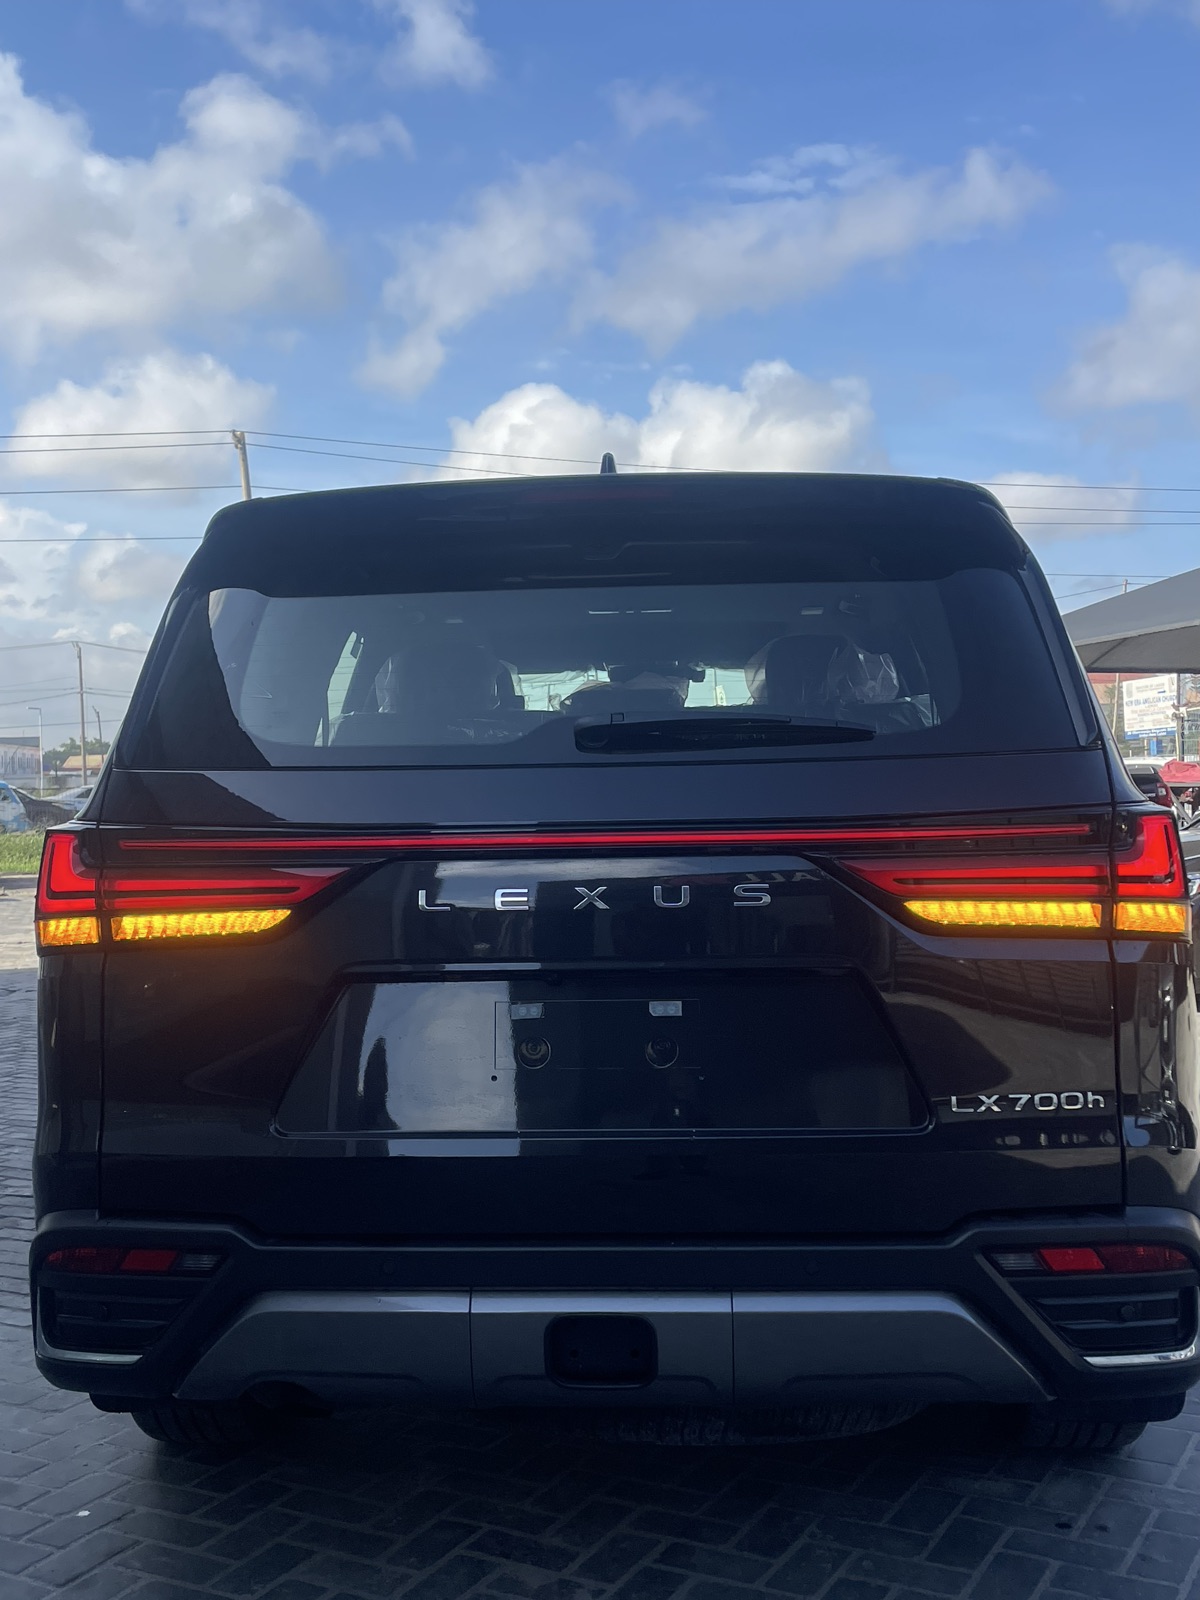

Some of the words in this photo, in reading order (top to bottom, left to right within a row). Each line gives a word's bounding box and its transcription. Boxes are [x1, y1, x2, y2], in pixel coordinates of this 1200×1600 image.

[1142, 696, 1161, 704] ANGLICAN
[418, 883, 772, 912] LEXUS
[950, 1095, 1002, 1113] LX
[1008, 1091, 1105, 1111] 700h
